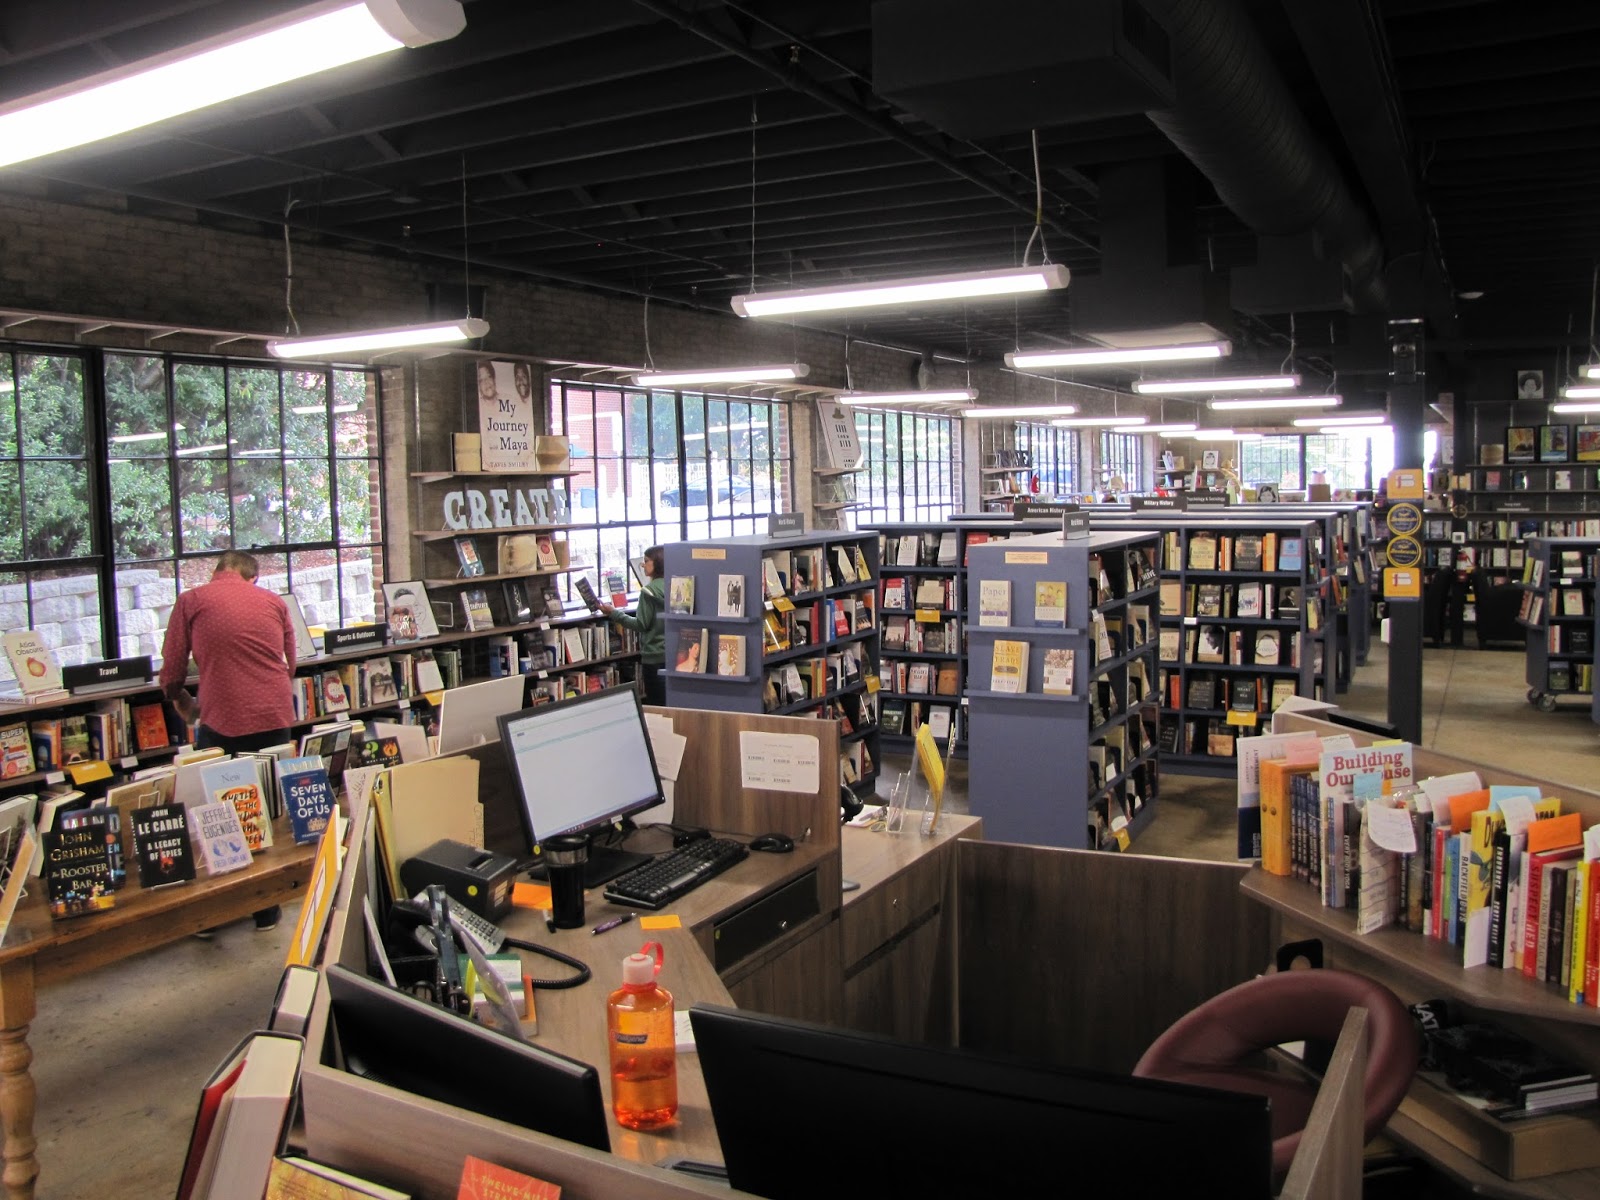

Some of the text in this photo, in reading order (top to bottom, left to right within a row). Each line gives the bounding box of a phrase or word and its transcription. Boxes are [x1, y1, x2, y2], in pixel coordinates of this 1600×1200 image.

[498, 399, 516, 418] My
[487, 417, 529, 437] Journey
[500, 436, 528, 455] Maya
[443, 488, 572, 531] CREATE
[982, 586, 1007, 596] Paper
[337, 631, 376, 643] Sports & Outdoors
[15, 647, 44, 656] Obscura
[99, 666, 119, 676] Travel
[0, 727, 25, 740] SUPER
[1333, 751, 1404, 772] Building
[220, 773, 241, 783] New
[290, 782, 327, 797] SEVEN
[297, 794, 326, 807] DAYS
[151, 808, 169, 818] JOHN
[201, 806, 232, 825] JEFFREY
[297, 804, 331, 818] OF US
[138, 822, 151, 836] LE
[152, 814, 185, 833] CARRÉ
[202, 819, 240, 840] EUGENIDES
[60, 831, 93, 846] JOHN
[147, 837, 182, 850] A LEGACY
[50, 844, 105, 861] GRISHAM
[150, 848, 183, 861] OF SPIES
[60, 863, 108, 879] ROOSTER
[72, 879, 93, 890] BAR
[1458, 855, 1469, 923] BACKFIELD BOYS
[1491, 846, 1504, 945] ENDURANCE SCOTT KELLY
[1525, 864, 1540, 949] SUSPECT RED
[481, 1175, 549, 1200] TWELVE-MIL
[483, 1188, 513, 1200] STRA
